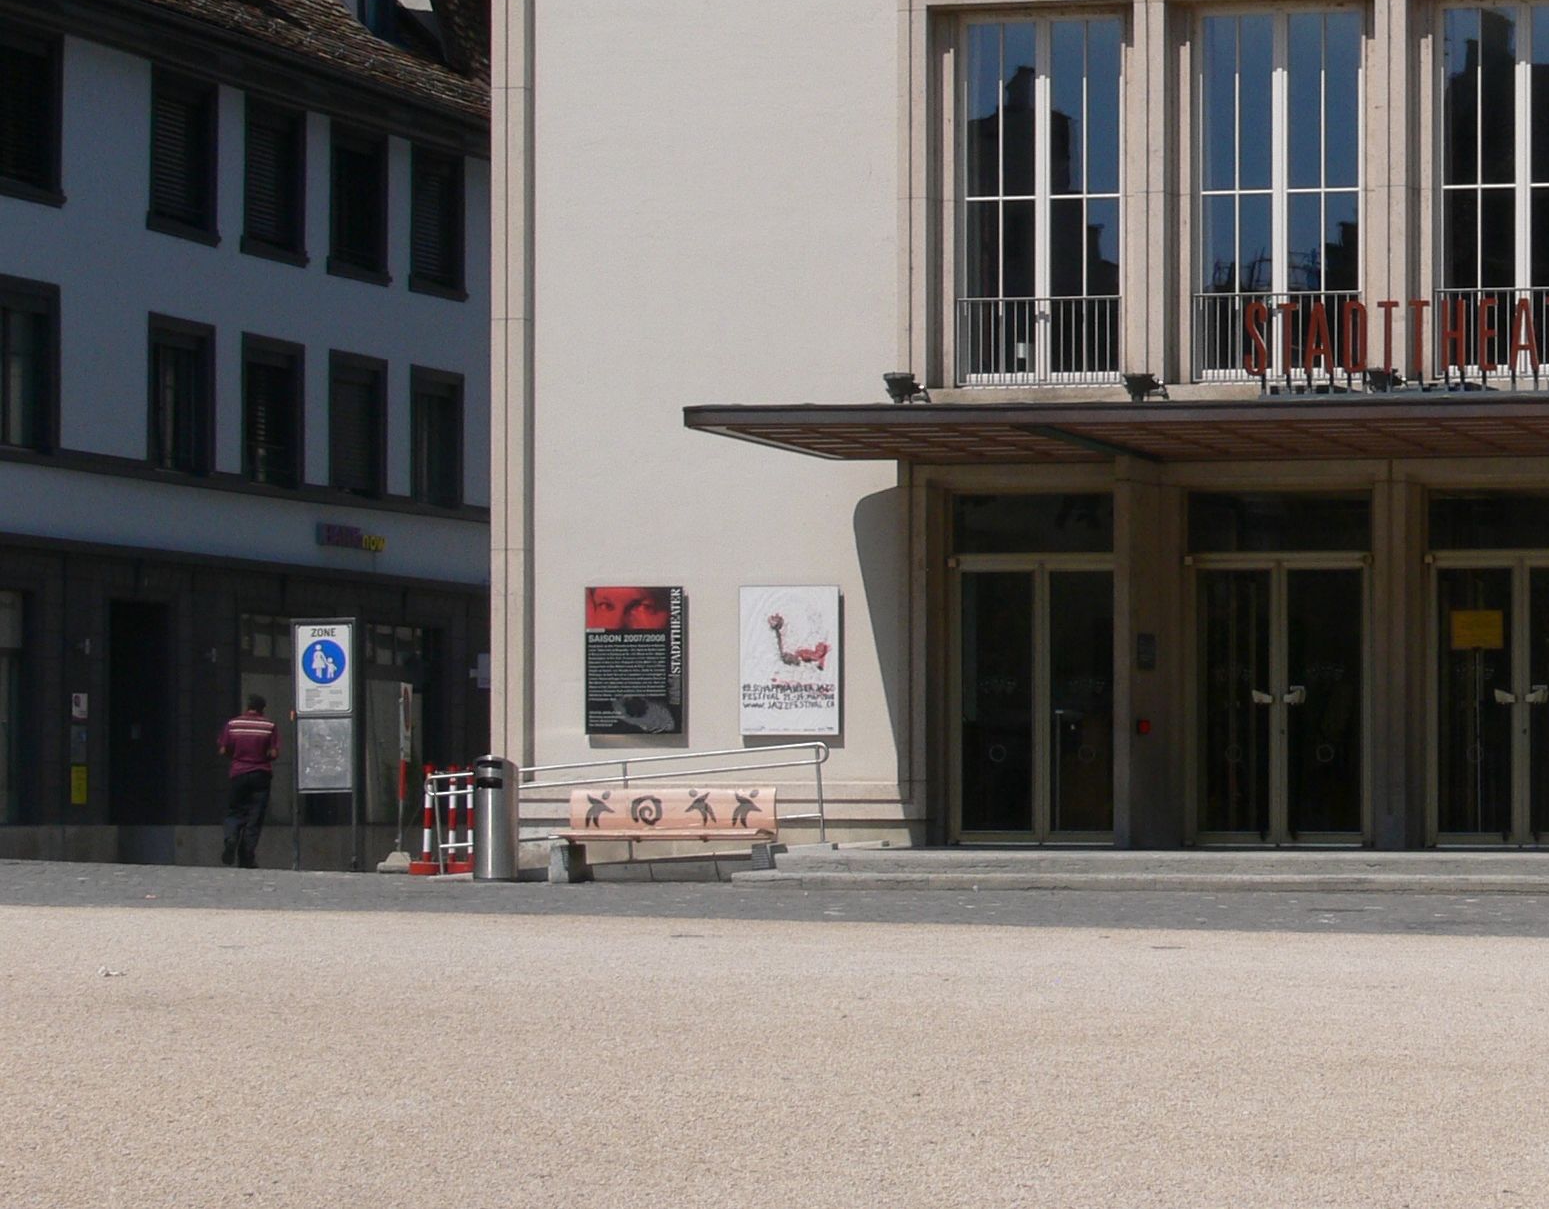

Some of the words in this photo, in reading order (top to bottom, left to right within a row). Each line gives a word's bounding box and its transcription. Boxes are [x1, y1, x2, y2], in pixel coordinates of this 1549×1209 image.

[311, 628, 337, 638] ZONE
[669, 587, 682, 674] STADTTHEATER
[588, 634, 622, 643] SAISON
[623, 634, 667, 643] 2007/2008
